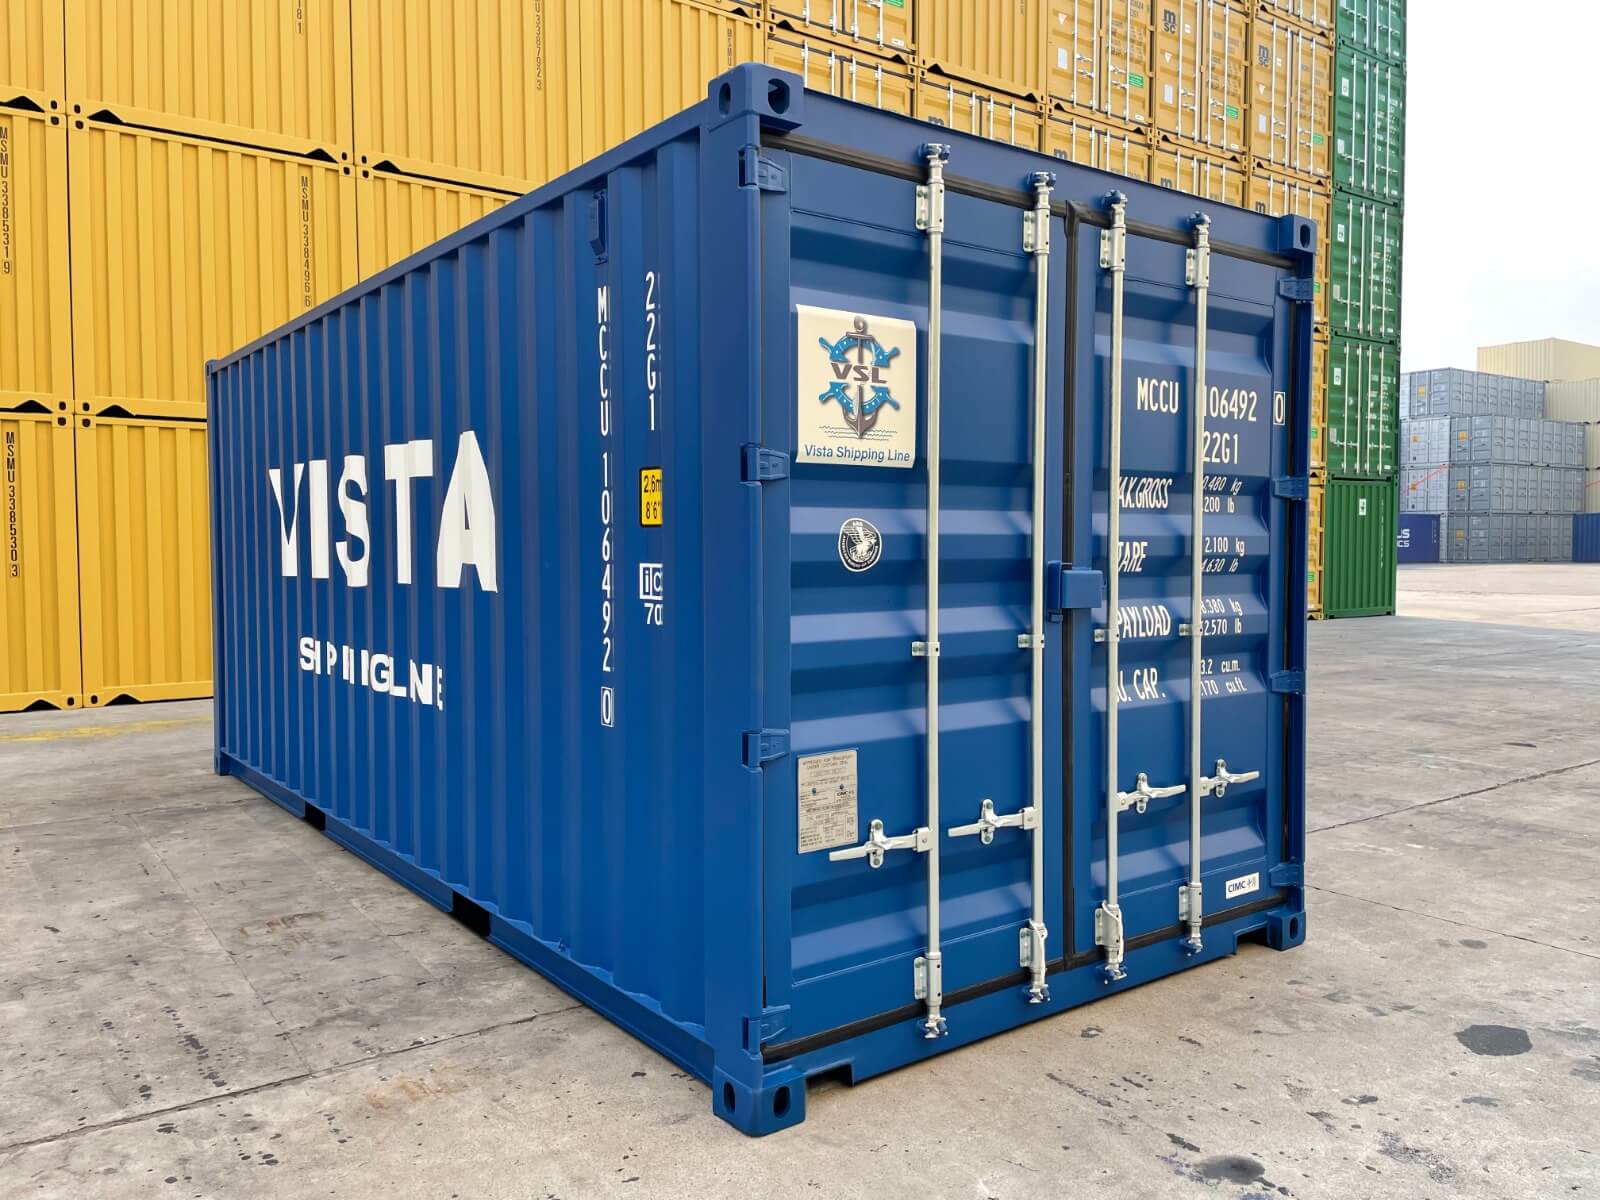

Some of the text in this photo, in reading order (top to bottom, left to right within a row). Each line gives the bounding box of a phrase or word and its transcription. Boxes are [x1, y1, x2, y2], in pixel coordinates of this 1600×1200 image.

[597, 286, 610, 437] MCCU
[645, 271, 658, 431] 22G1
[831, 362, 887, 384] VSL
[1137, 377, 1179, 413] MCCU
[6, 432, 15, 482] MSMU
[804, 443, 911, 462] Vista Shipping Line
[268, 430, 498, 593] VISTA
[601, 451, 613, 673] 106492
[1205, 537, 1228, 553] 2.100
[1235, 537, 1245, 557] kg
[1227, 880, 1246, 893] CIMC
